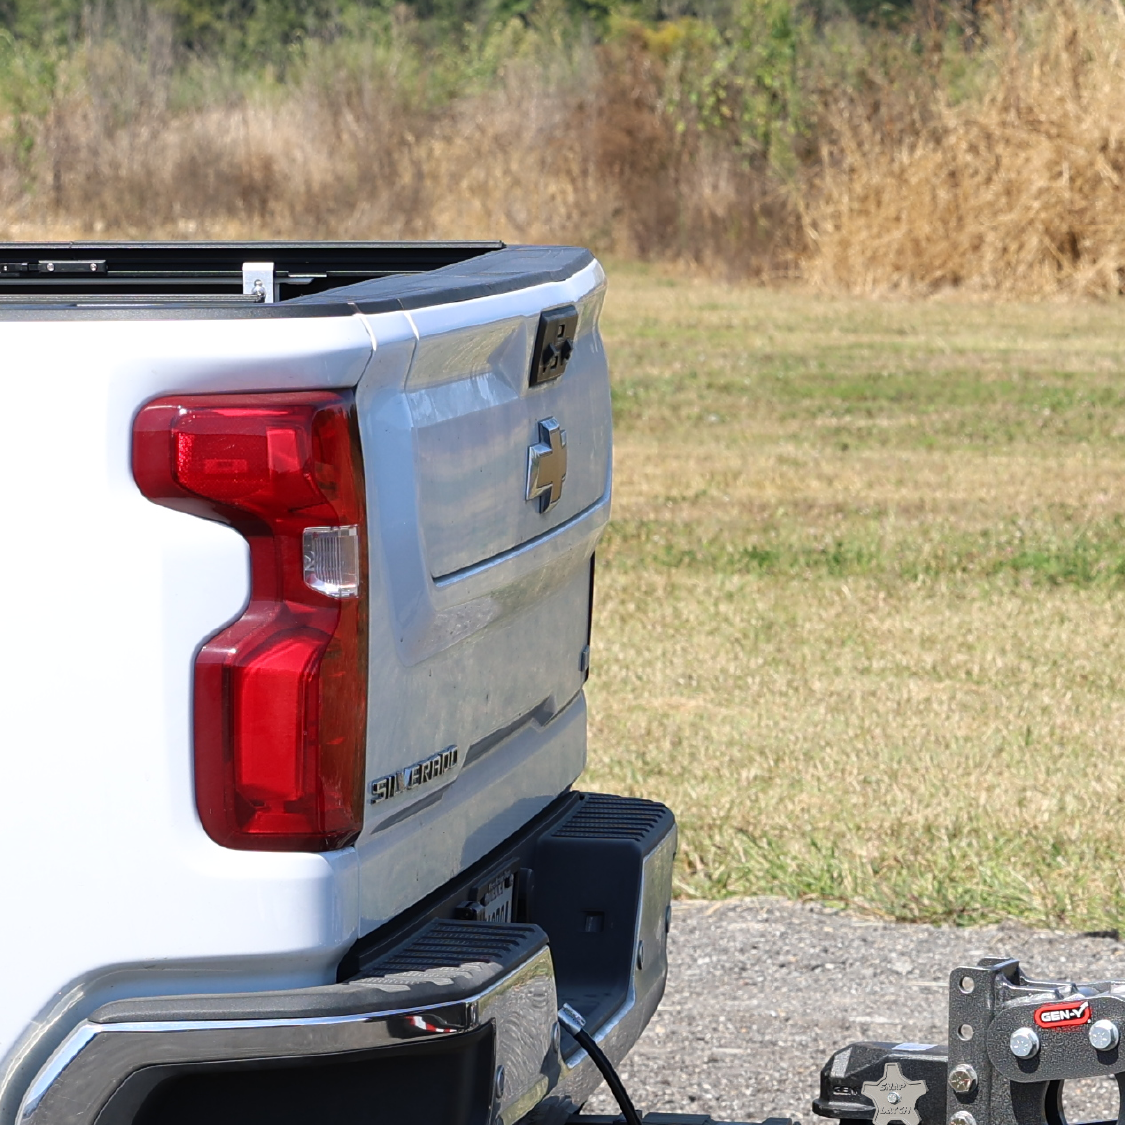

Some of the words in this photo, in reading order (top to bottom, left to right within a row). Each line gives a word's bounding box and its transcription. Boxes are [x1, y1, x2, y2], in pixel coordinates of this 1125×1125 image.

[369, 745, 458, 804] SILVERADO
[1041, 1001, 1089, 1022] GEN-Y
[879, 1082, 907, 1092] SNAP
